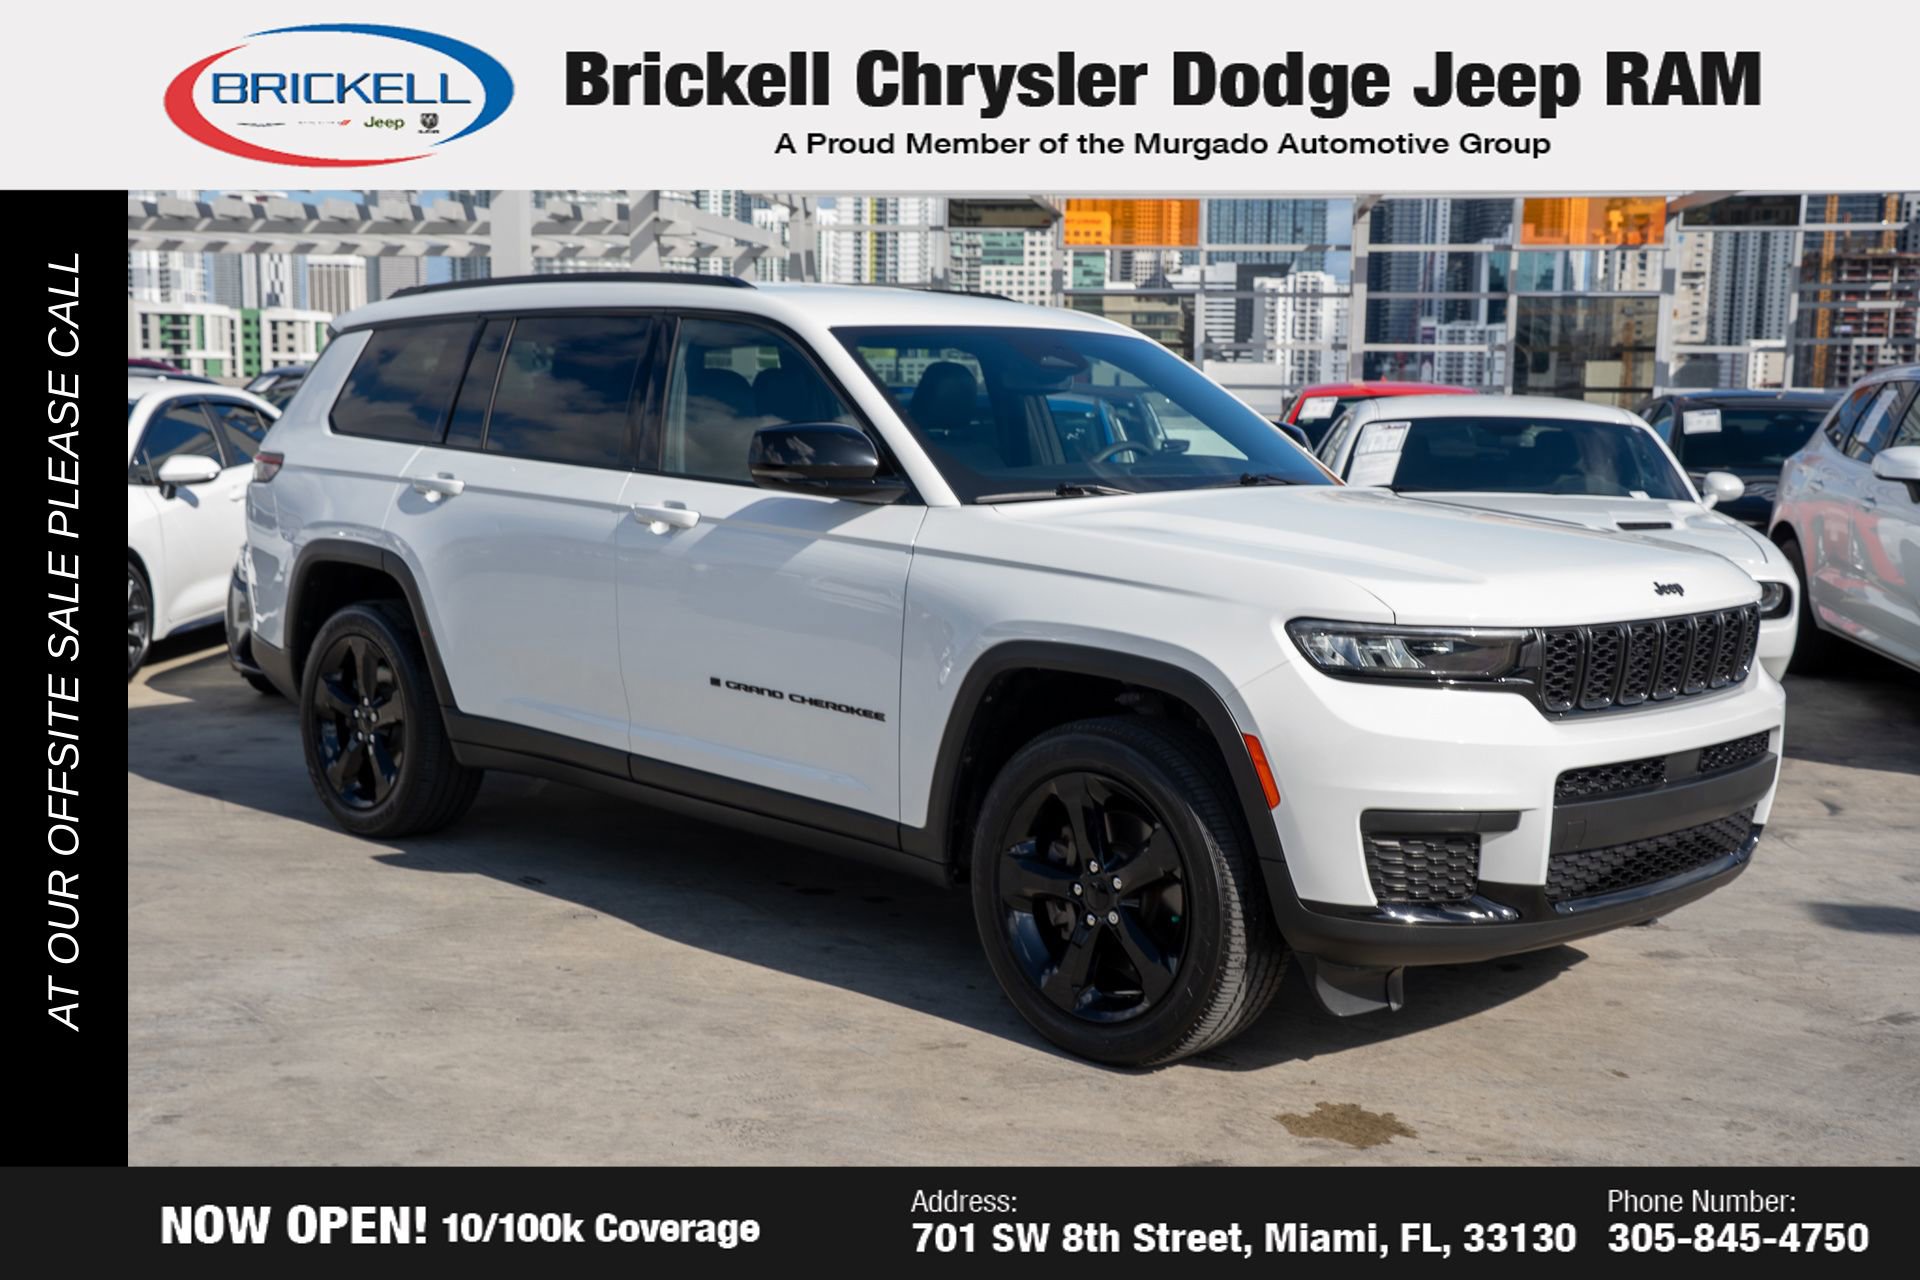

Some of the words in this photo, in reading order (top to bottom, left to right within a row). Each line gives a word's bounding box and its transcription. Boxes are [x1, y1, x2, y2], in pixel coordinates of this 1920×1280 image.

[1653, 581, 1685, 597] Jeep
[725, 680, 784, 700] GRAND
[788, 693, 886, 722] CHEROKEE
